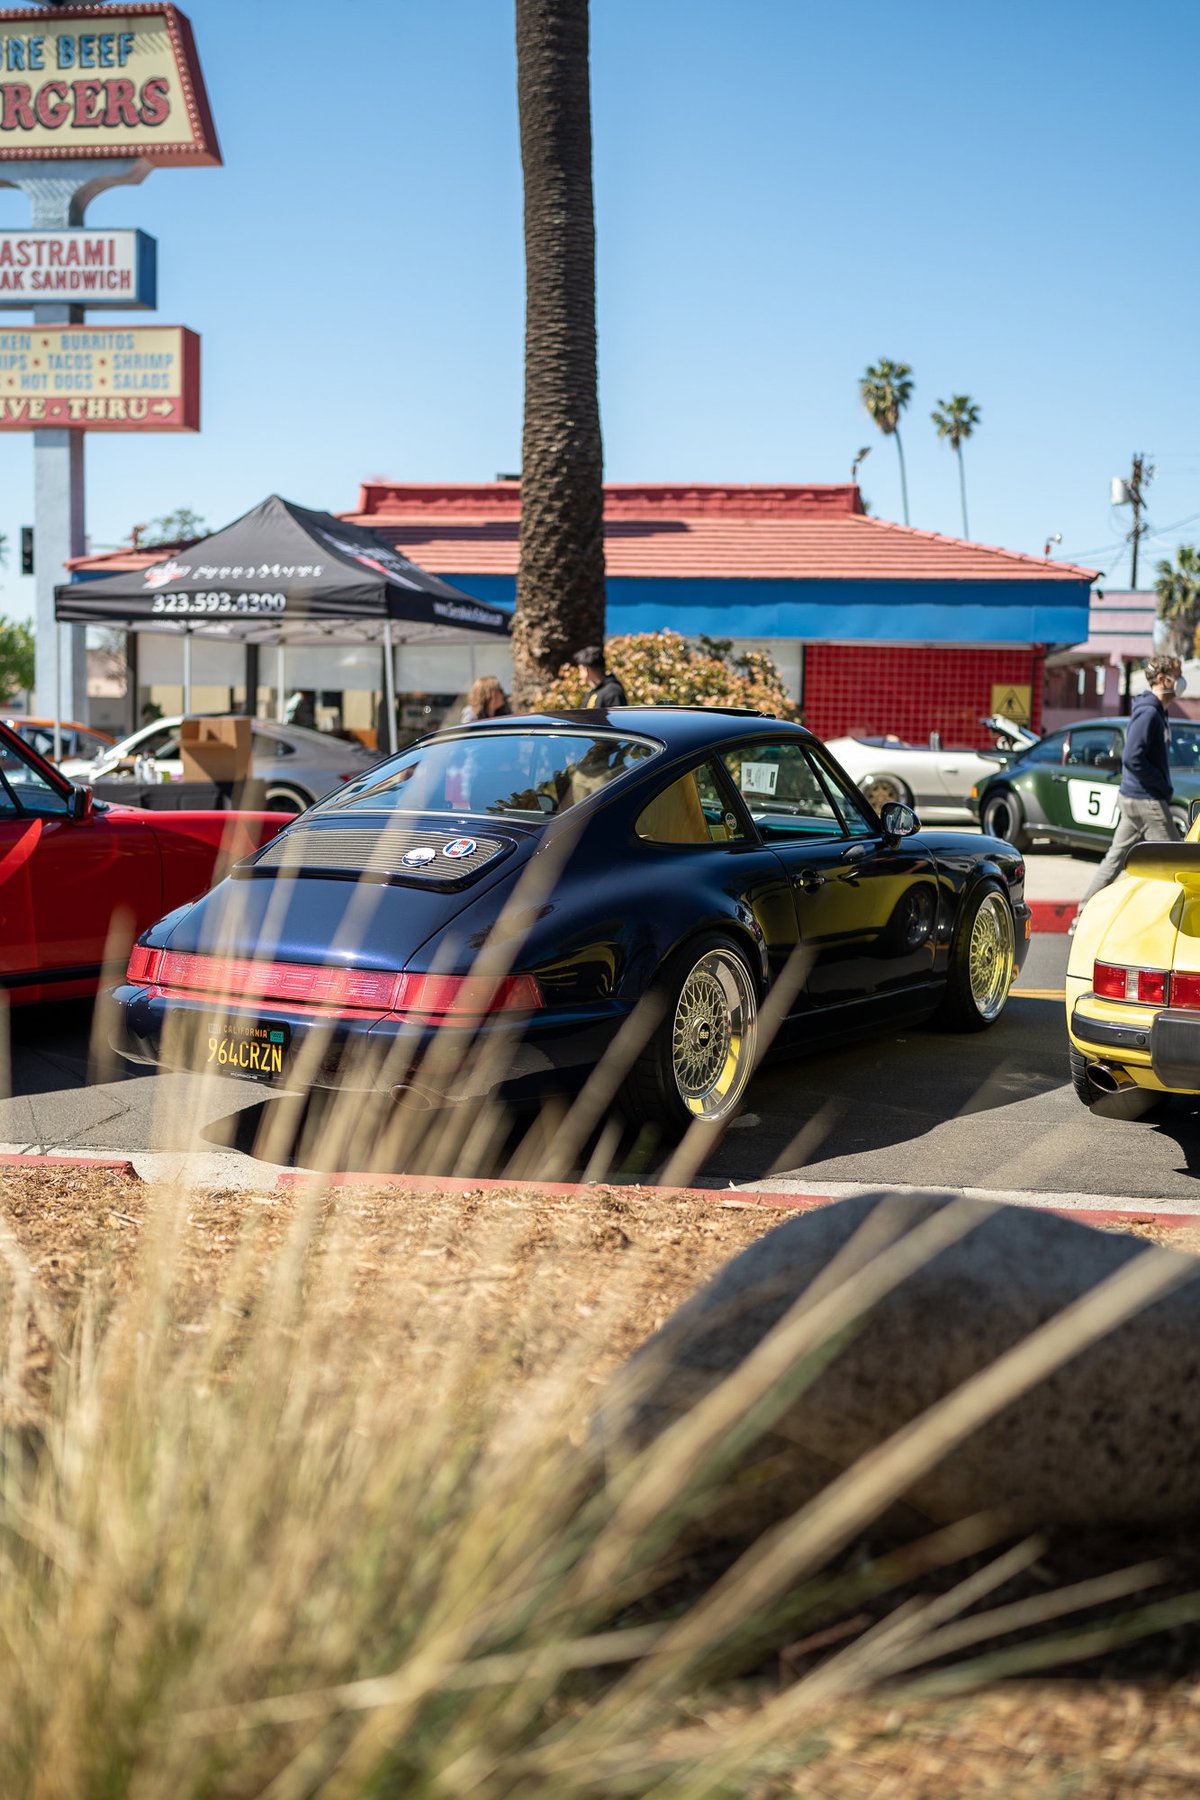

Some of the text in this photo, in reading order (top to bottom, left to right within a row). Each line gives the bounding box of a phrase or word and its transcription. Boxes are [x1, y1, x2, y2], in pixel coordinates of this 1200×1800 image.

[0, 33, 135, 71] RE BEEF
[0, 77, 171, 130] RGERS
[0, 239, 115, 267] ASTRAMI
[0, 269, 131, 290] AK SANDWICH
[61, 332, 135, 351] BURRITOS
[48, 353, 93, 371] TACOS
[112, 352, 174, 370] SHRIMP
[21, 373, 170, 391] HOT DOGS SALADS
[69, 398, 148, 420] THRU
[1088, 790, 1101, 816] 5
[223, 1024, 268, 1039] CALIFORNIA
[207, 1037, 283, 1074] 964CRZN
